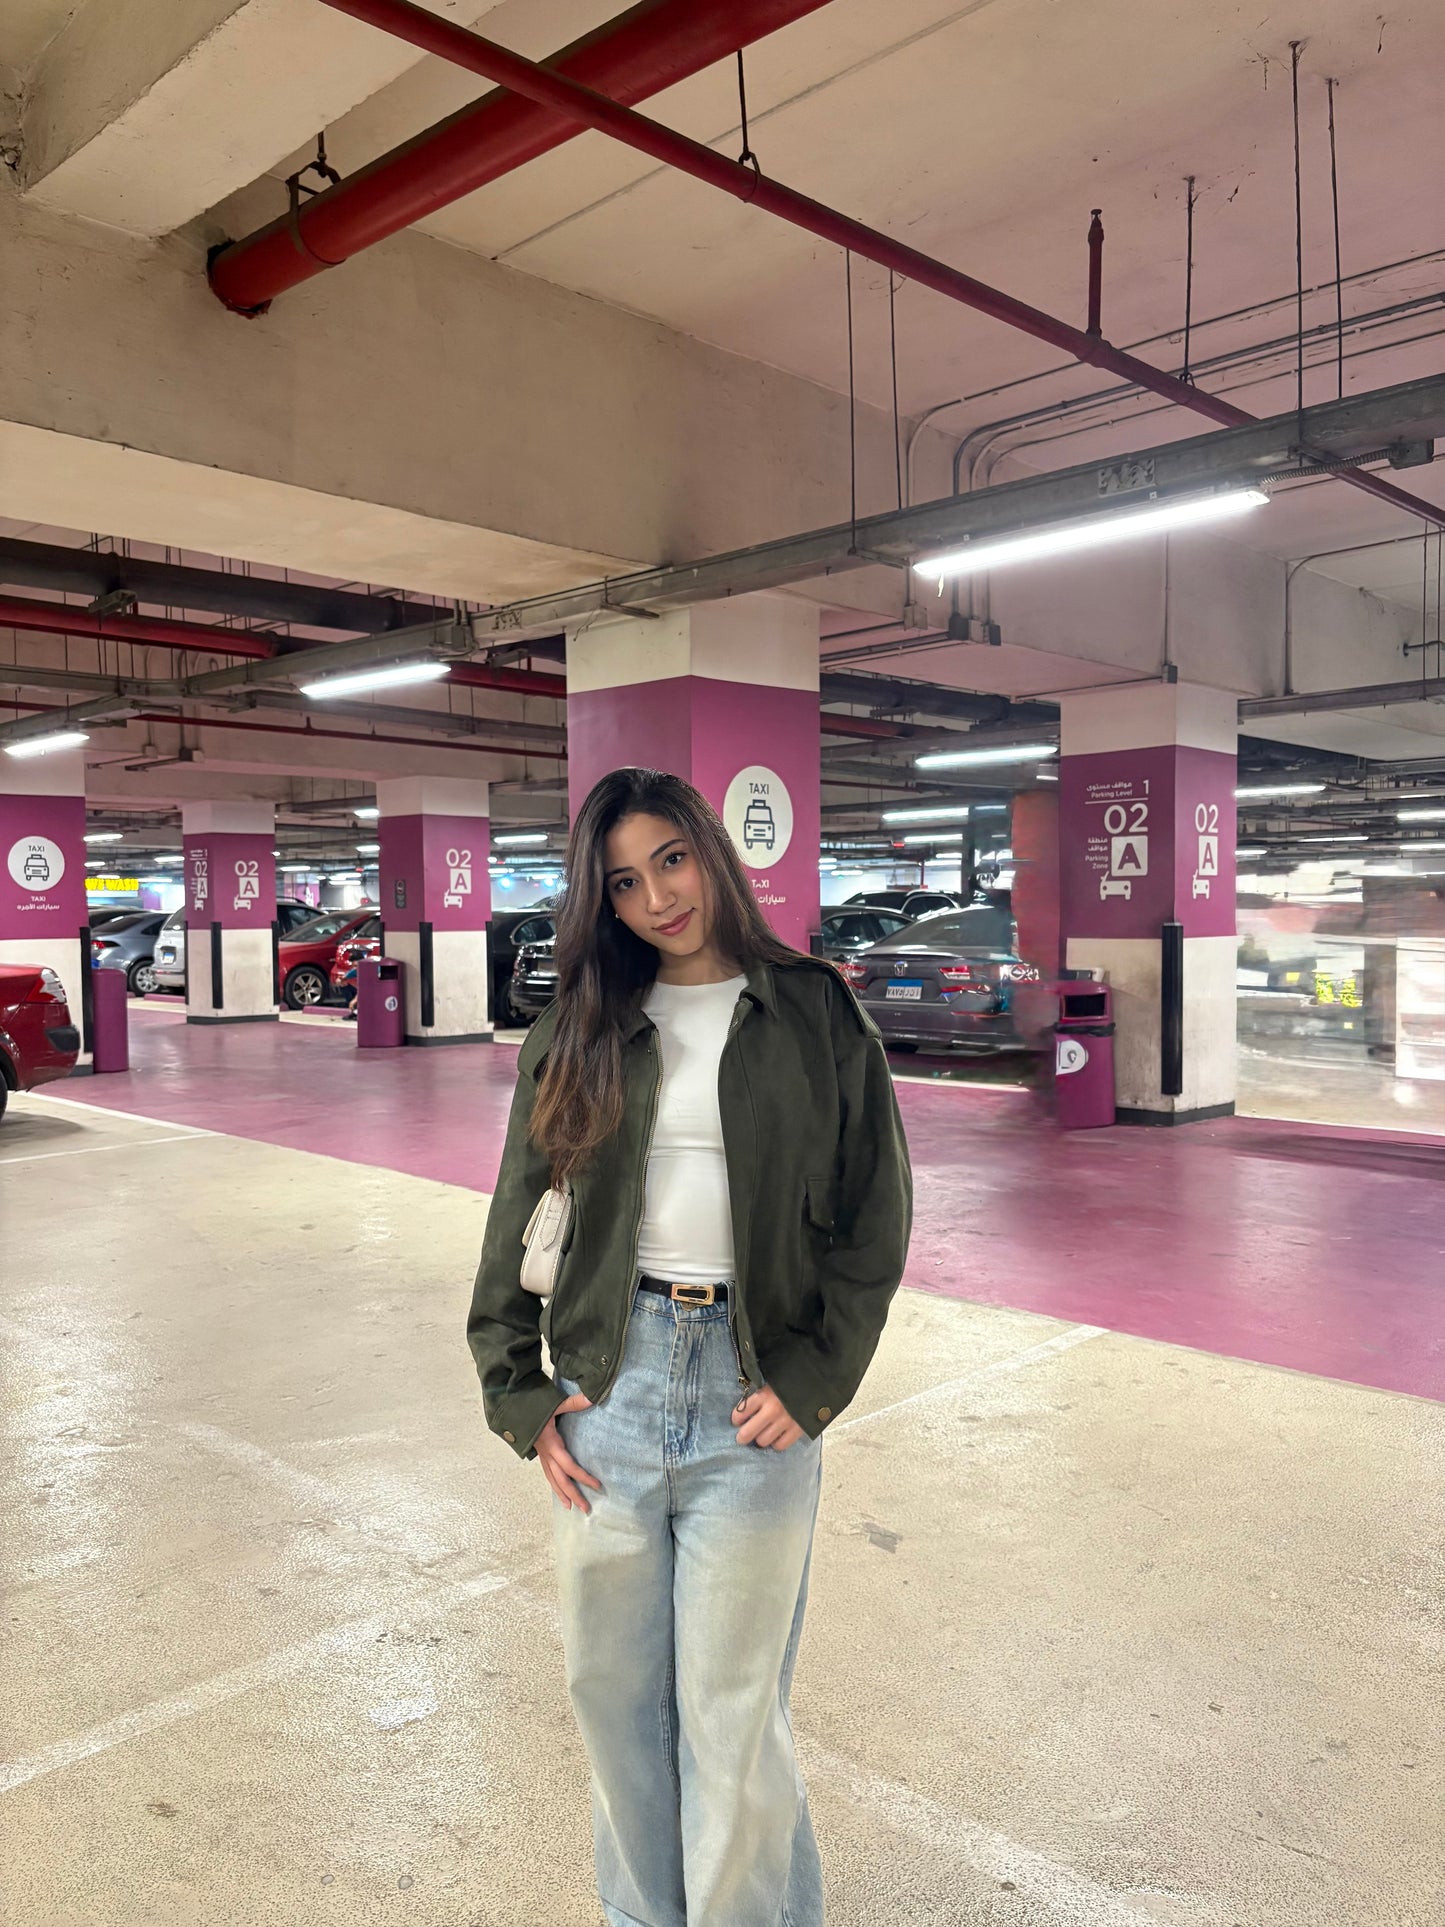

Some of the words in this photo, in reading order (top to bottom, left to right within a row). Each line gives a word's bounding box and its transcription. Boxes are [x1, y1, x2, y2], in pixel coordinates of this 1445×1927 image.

[749, 782, 770, 795] TAXI
[1086, 783, 1111, 792] مستوى
[1111, 781, 1132, 789] مواقف
[1143, 779, 1149, 794] 1
[1091, 790, 1115, 799] Parking
[1115, 789, 1133, 797] Level
[1104, 802, 1148, 834] 02
[1195, 803, 1219, 833] 02
[1087, 844, 1108, 852] مواقف
[1202, 842, 1215, 869] A
[446, 848, 472, 868] 02
[1085, 854, 1109, 863] Parking
[1117, 842, 1142, 870] A
[195, 861, 208, 876] 02
[234, 860, 259, 876] 02
[105, 878, 139, 891] WASH
[243, 880, 256, 895] A
[454, 872, 468, 890] A
[36, 903, 60, 911] سيارات
[757, 894, 786, 905] سيارات
